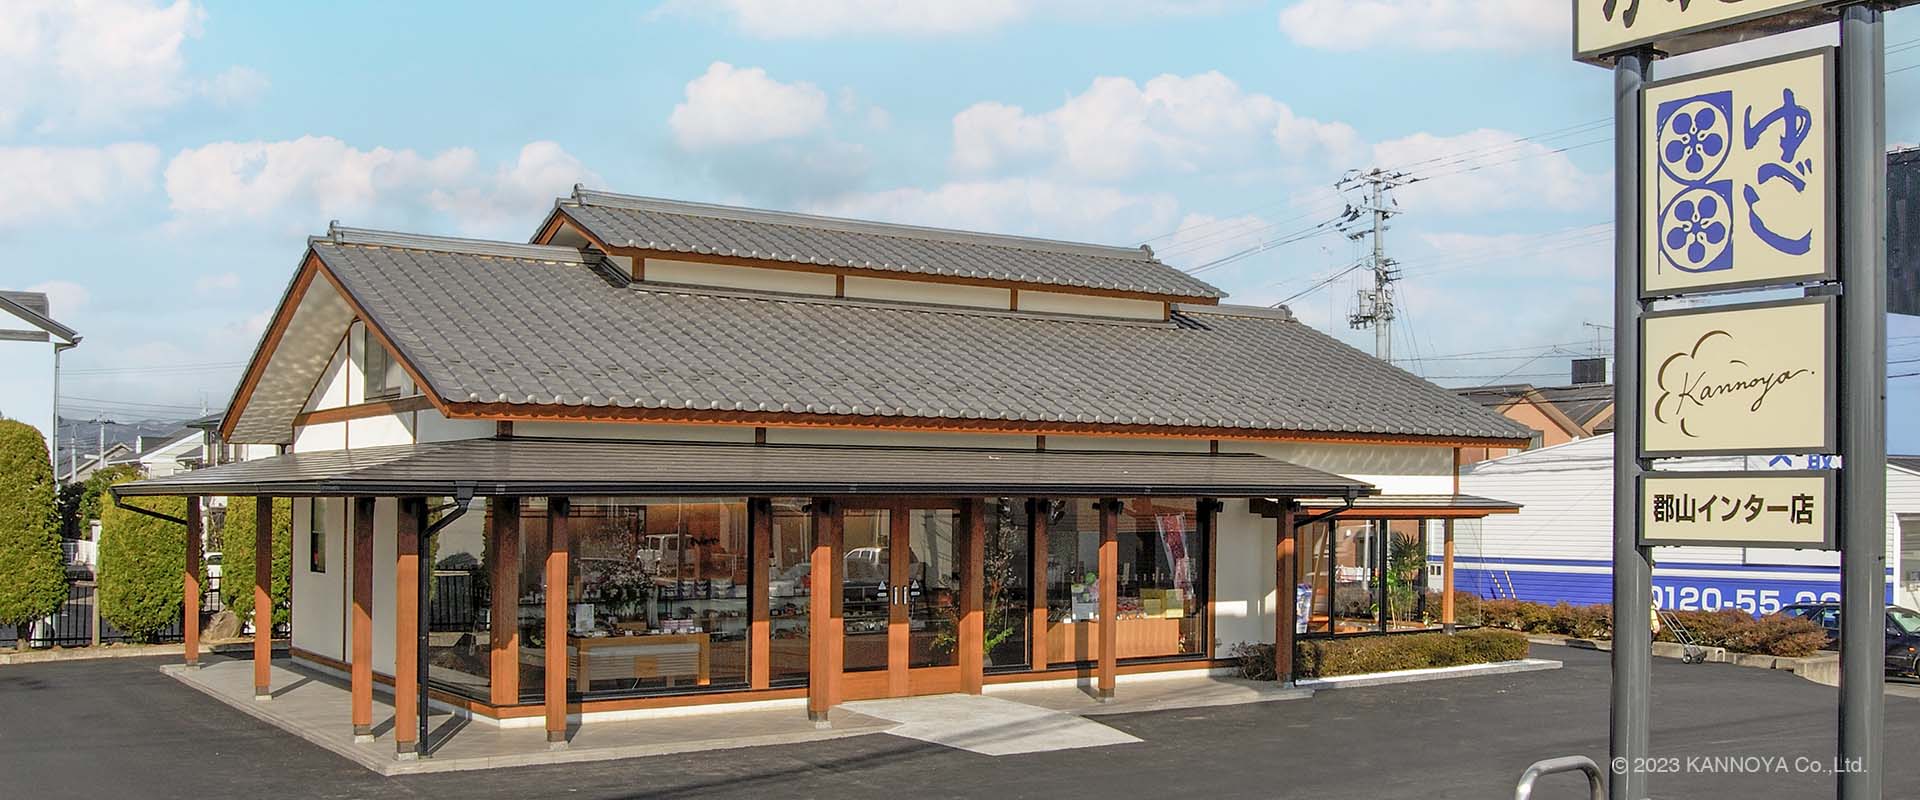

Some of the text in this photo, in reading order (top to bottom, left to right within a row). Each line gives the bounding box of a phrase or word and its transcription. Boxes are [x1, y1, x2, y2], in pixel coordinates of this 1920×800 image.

[1744, 88, 1812, 256] ゆべし
[1653, 493, 1814, 525] 郡山インター店
